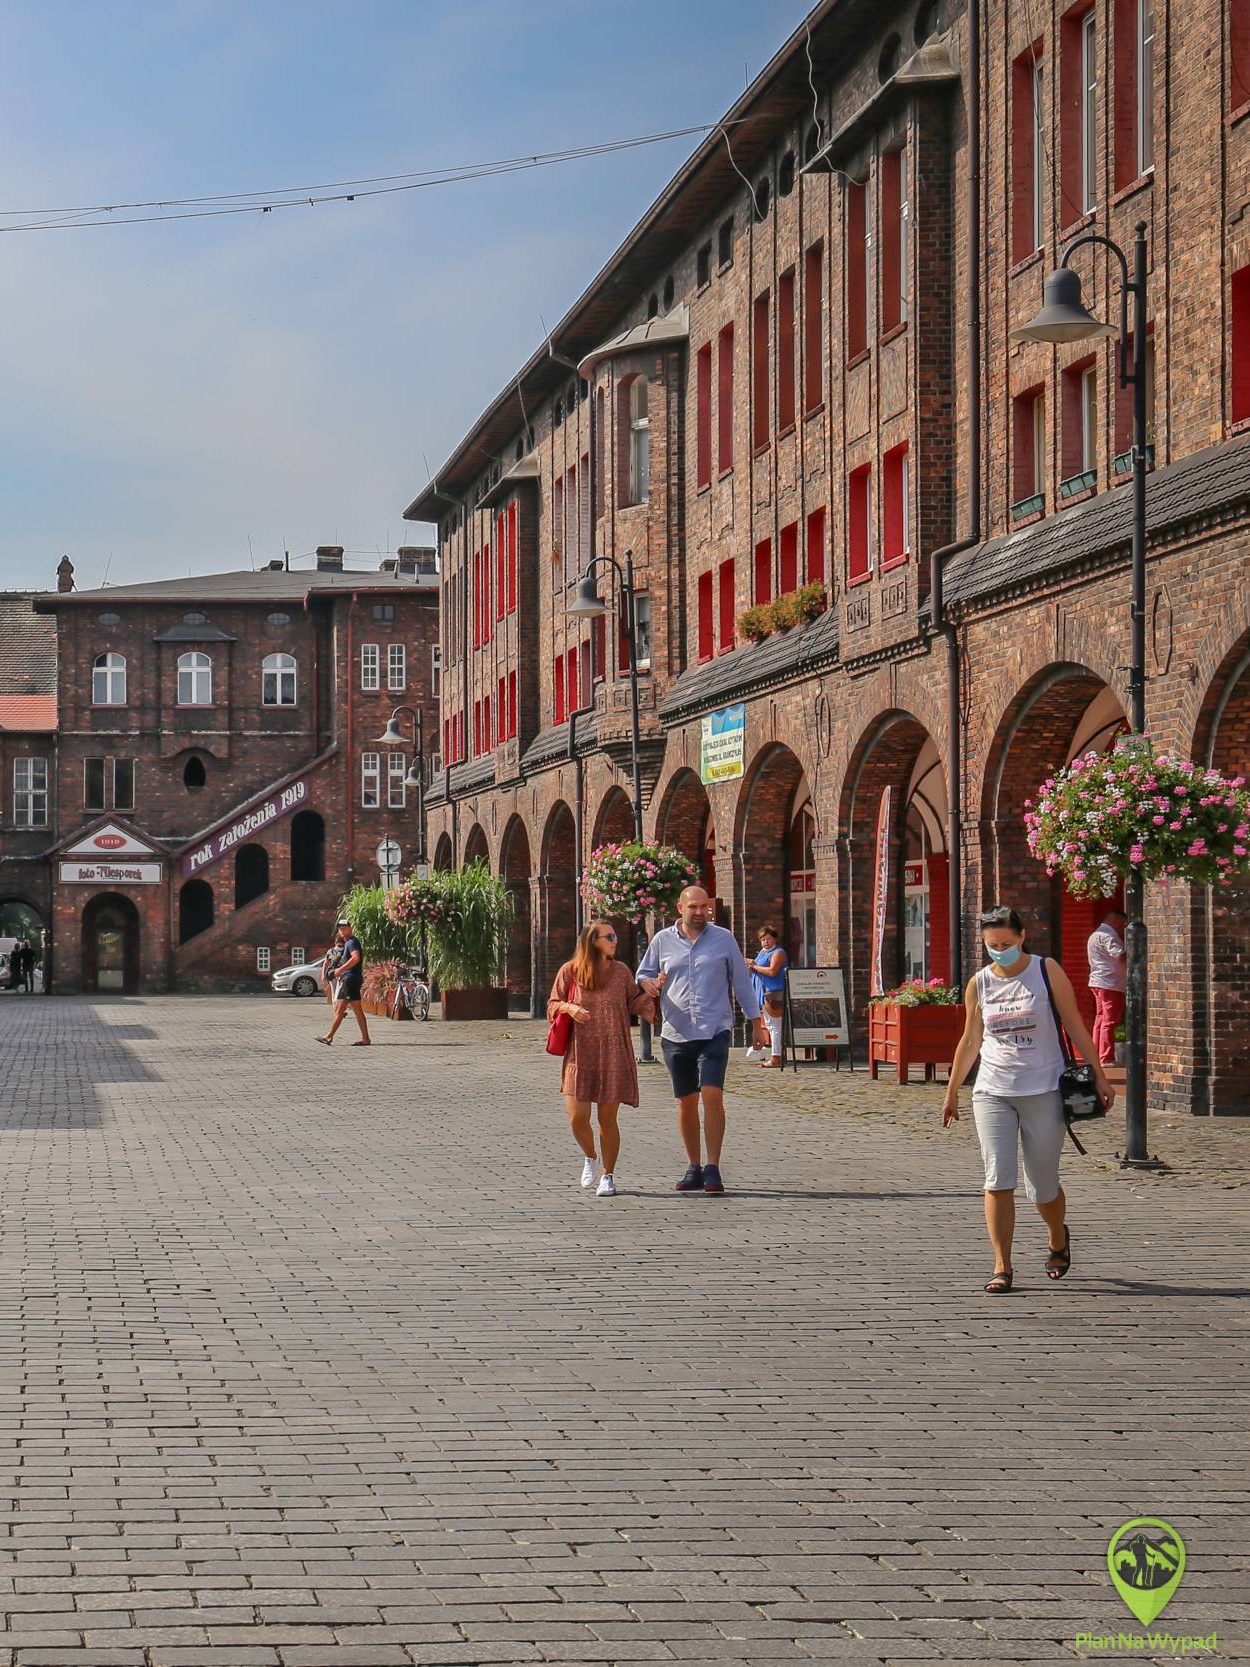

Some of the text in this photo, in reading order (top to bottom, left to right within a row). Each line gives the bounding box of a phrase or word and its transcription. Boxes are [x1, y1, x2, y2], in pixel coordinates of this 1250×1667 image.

[190, 781, 305, 870] rok założenia 1919
